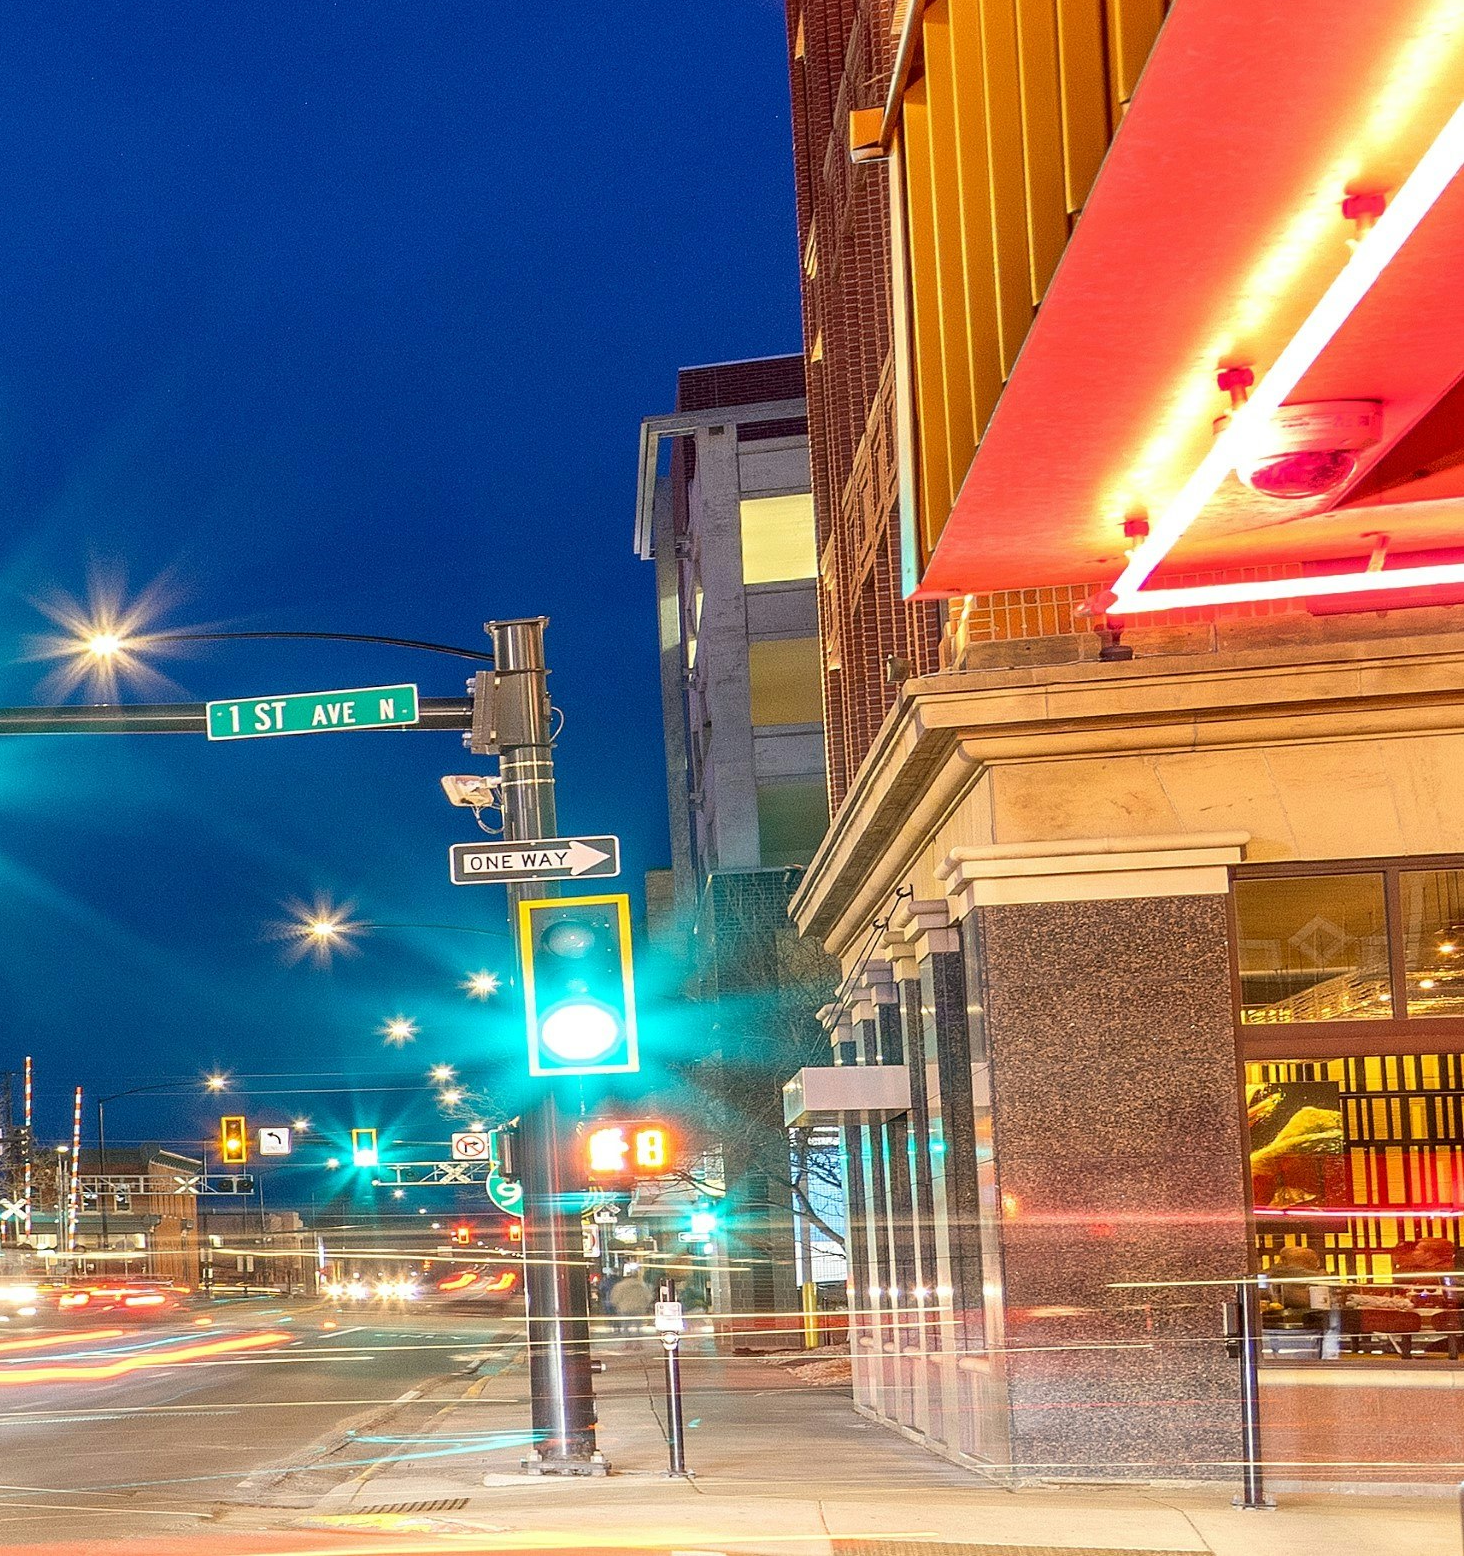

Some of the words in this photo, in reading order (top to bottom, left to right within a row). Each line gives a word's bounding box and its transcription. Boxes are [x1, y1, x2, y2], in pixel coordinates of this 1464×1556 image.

[311, 701, 356, 727] AVE
[379, 698, 394, 721] N
[470, 855, 513, 871] ONE
[521, 851, 568, 868] WAY
[496, 1183, 523, 1206] 9
